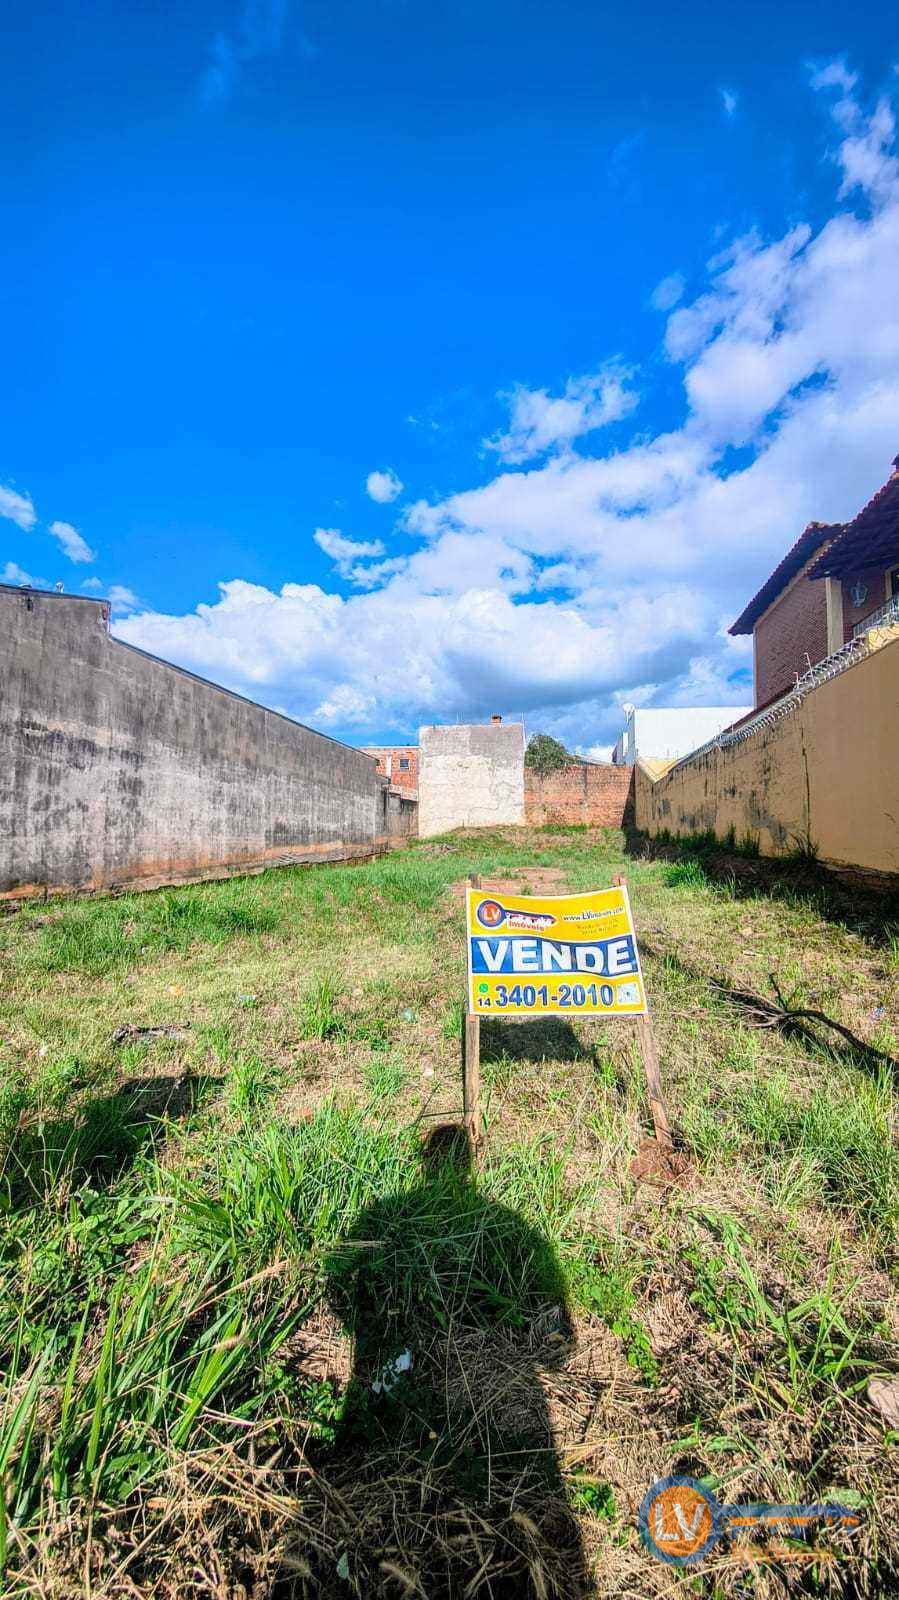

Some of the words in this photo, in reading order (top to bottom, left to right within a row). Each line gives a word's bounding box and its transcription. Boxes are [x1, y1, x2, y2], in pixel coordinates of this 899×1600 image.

[483, 906, 501, 921] LV
[477, 939, 633, 975] VENDE
[477, 997, 491, 1007] 14
[495, 983, 614, 1007] 3401-2010
